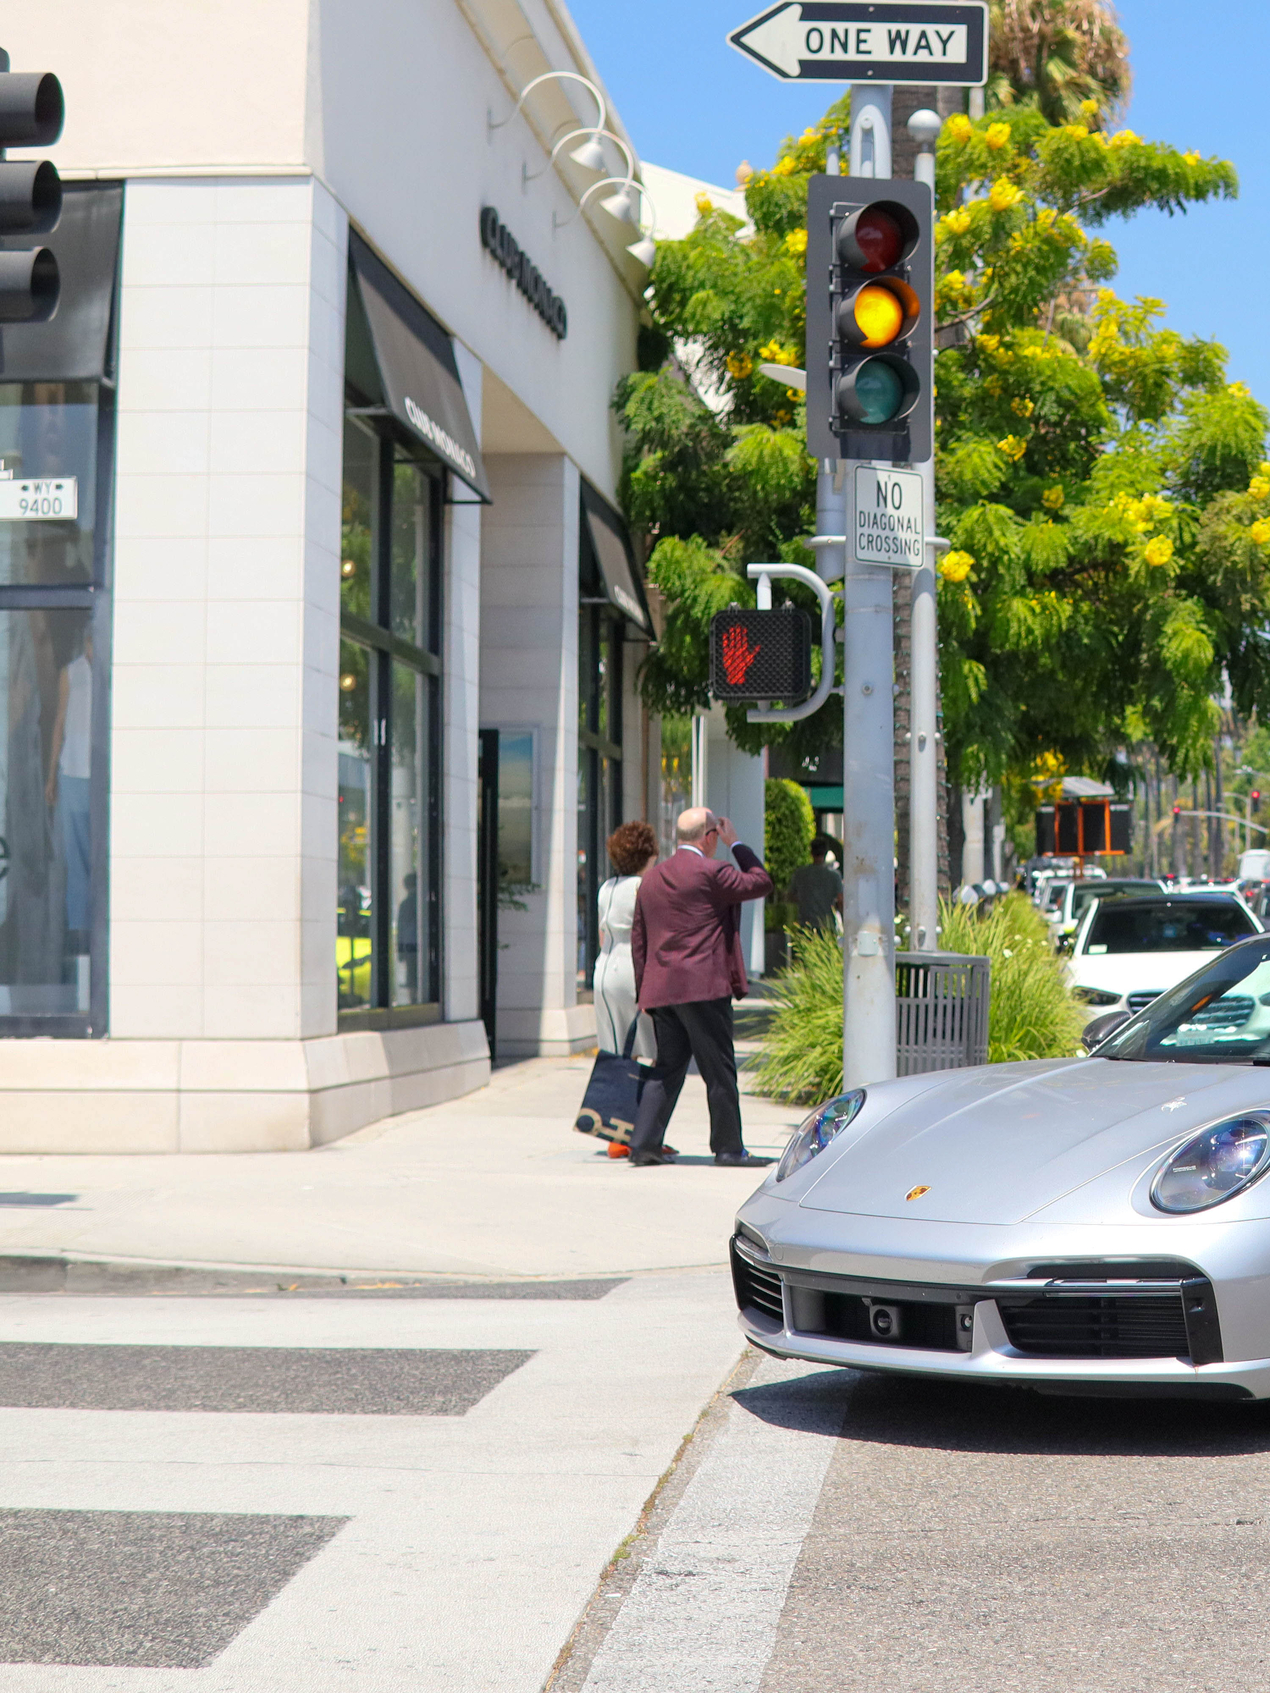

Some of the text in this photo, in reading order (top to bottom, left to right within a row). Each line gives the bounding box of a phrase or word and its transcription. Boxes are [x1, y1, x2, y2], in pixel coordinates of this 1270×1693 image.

[805, 27, 955, 57] ONE WAY
[404, 396, 476, 479] CLUB MONACO
[33, 482, 52, 495] WY
[876, 480, 902, 510] NO
[19, 497, 63, 516] 9400
[858, 510, 921, 535] DIAGONAL
[858, 532, 921, 557] CROSSING
